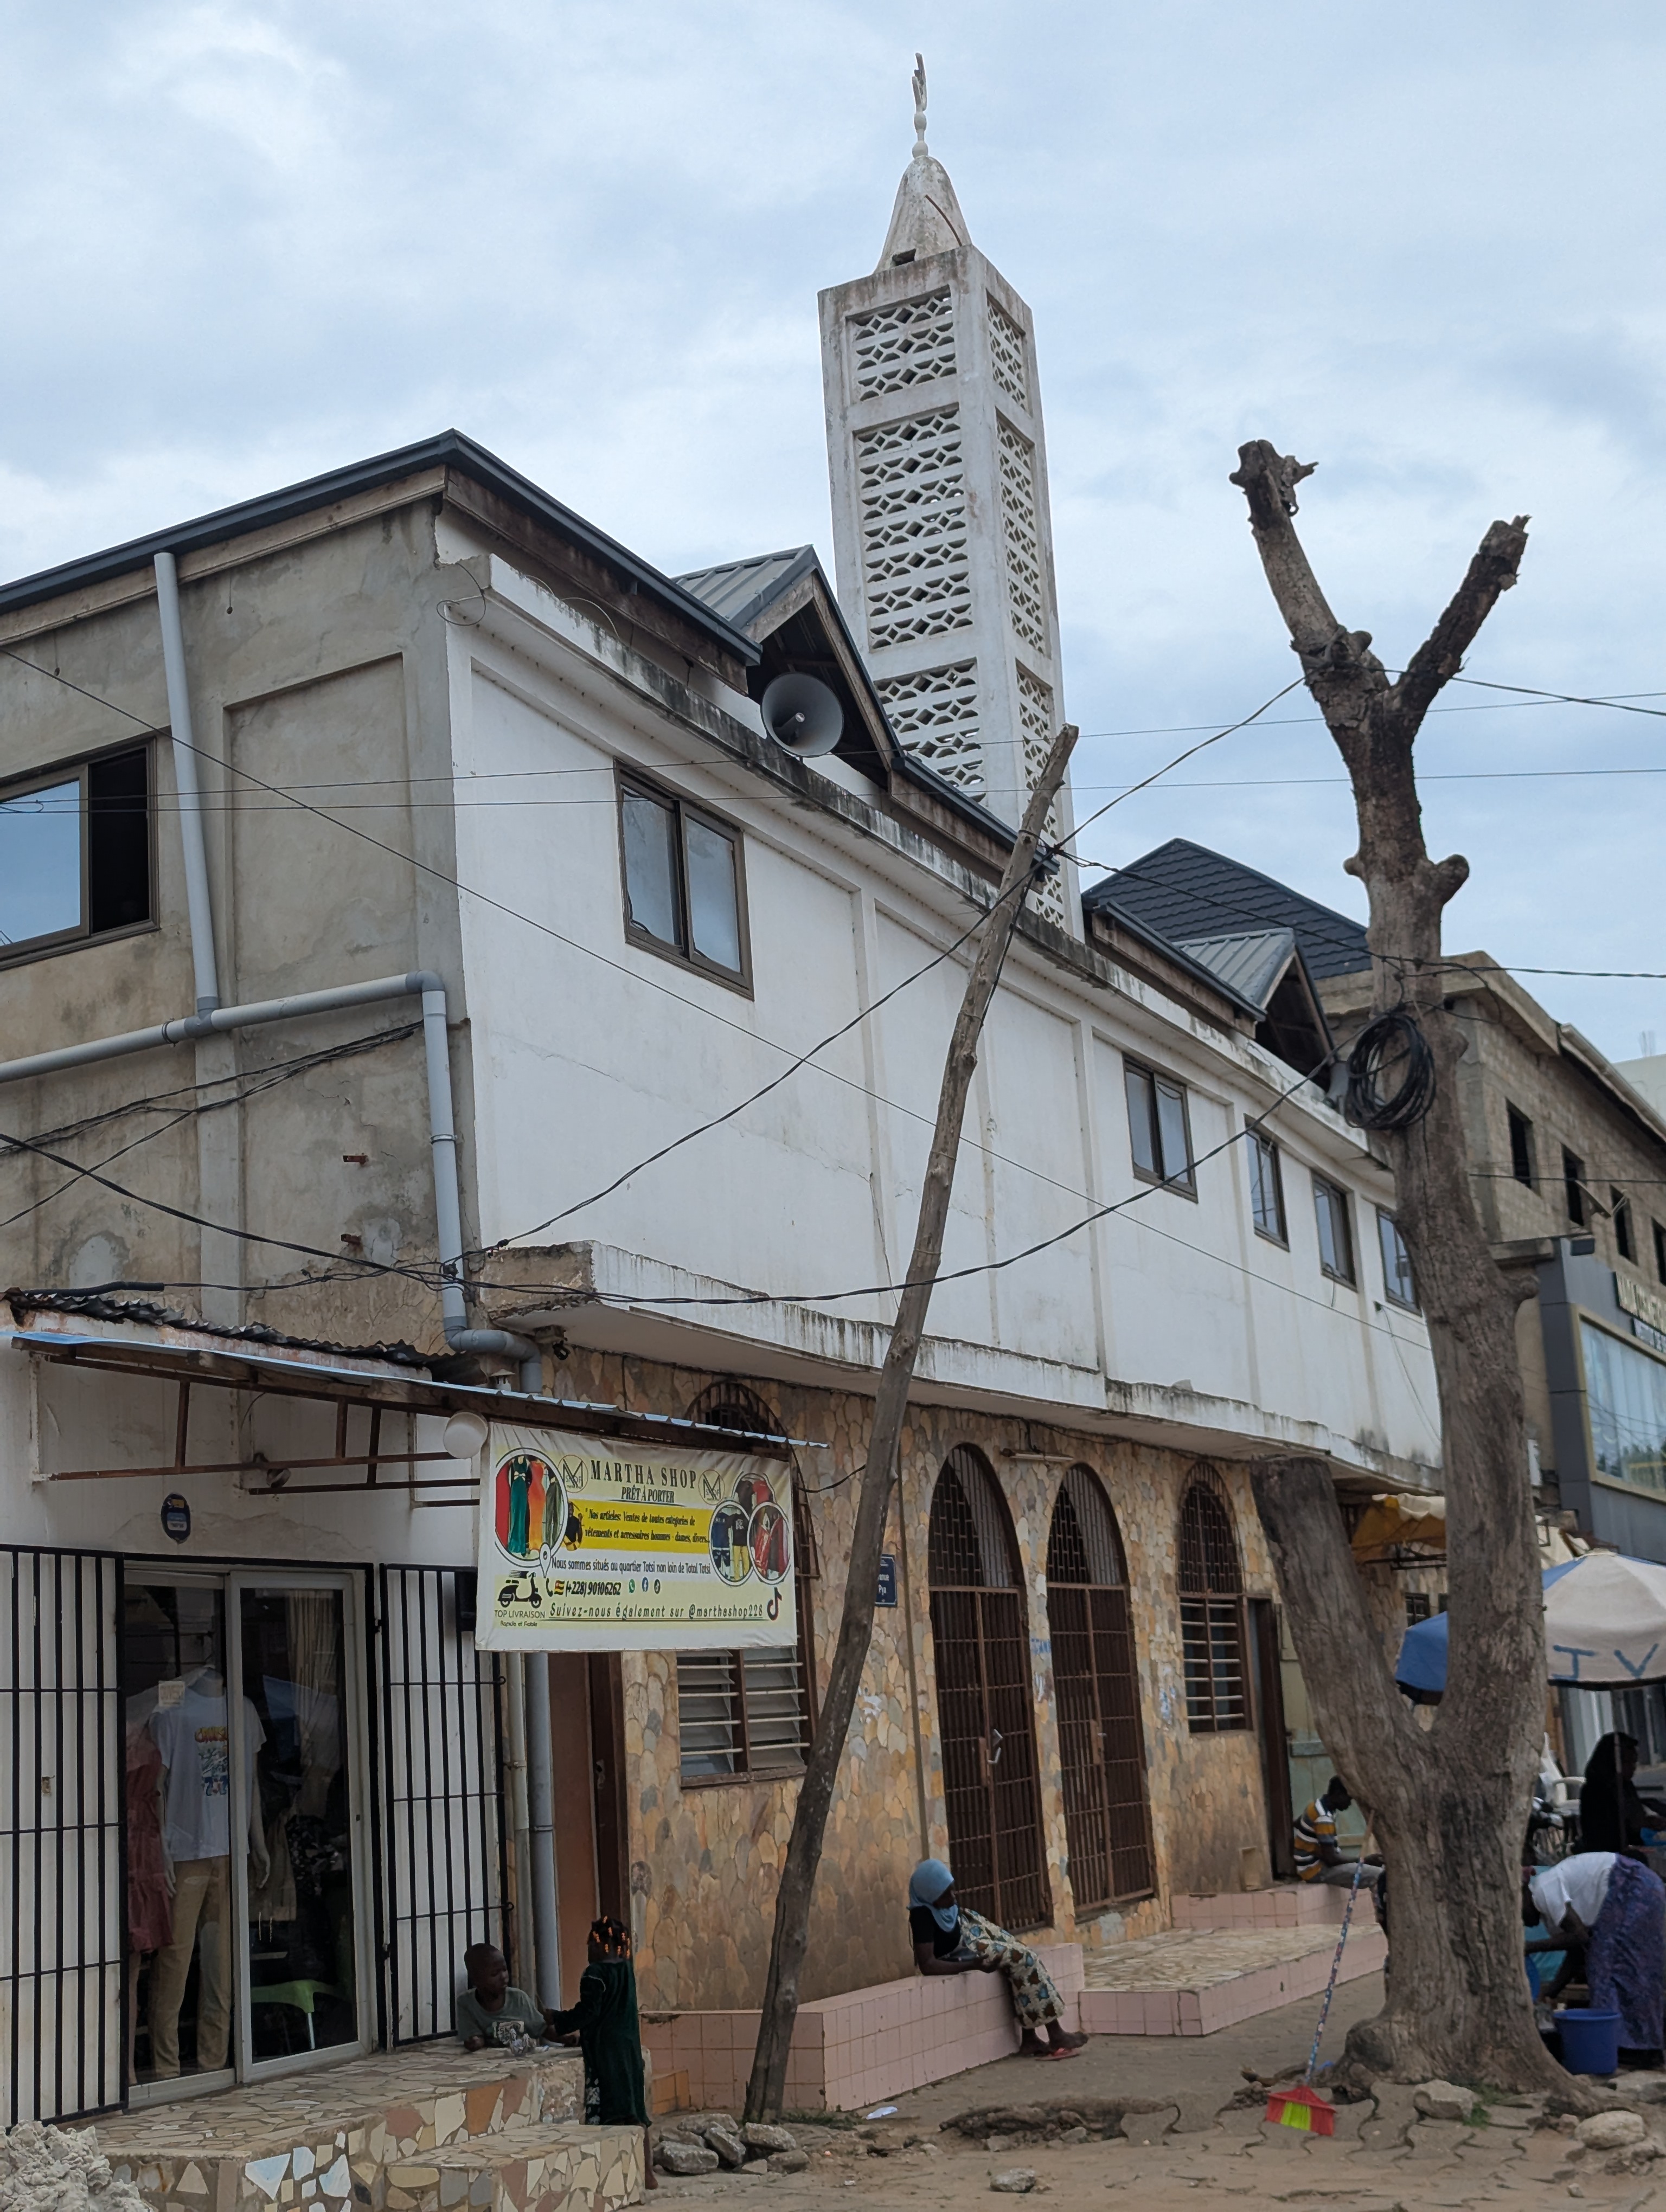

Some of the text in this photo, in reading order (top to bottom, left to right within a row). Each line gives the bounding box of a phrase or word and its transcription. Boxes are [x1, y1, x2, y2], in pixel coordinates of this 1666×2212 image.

[591, 1459, 696, 1489] MARTHA SHOP
[621, 1484, 675, 1503] PRÊT À PORTER
[624, 1511, 640, 1522] Ventes
[642, 1512, 648, 1523] de
[649, 1514, 664, 1523] toutes
[689, 1515, 696, 1526] de
[613, 1529, 619, 1539] et
[620, 1530, 650, 1540] accessoires
[552, 1557, 711, 1575] Nous sommes situés au quartier Totsi non loin de Total Totsi
[494, 1610, 546, 1619] TOP LIVRAISON
[550, 1602, 764, 1621] Suivez-nous également sur @marthashop228
